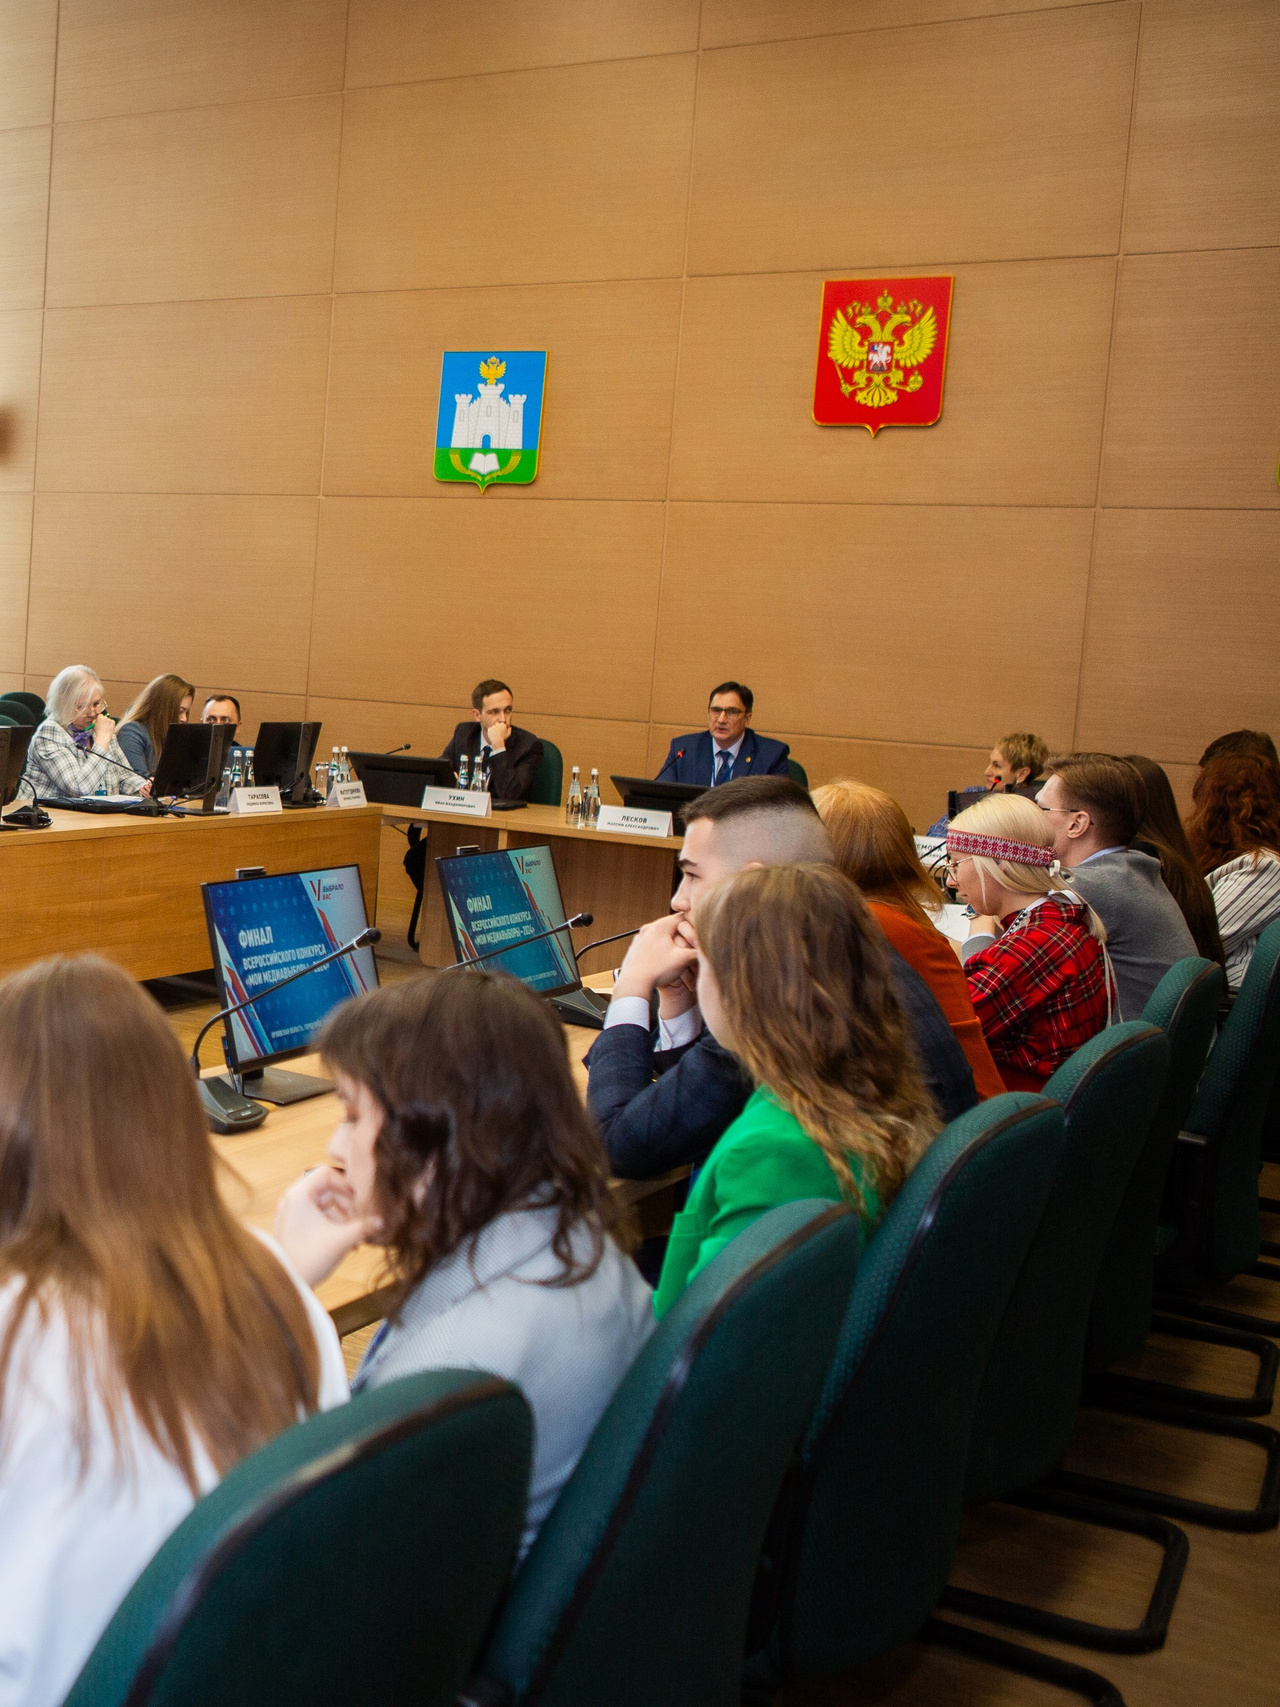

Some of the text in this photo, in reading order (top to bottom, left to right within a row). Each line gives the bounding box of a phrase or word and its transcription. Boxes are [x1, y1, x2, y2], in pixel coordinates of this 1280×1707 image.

[621, 815, 648, 824] ЛЕСКОВ
[322, 883, 345, 892] ВЫБРАЛО
[322, 893, 332, 901] ВАС
[466, 895, 492, 913] ФИНАЛ
[471, 911, 532, 932] ВСЕРОССИЙСКОГО КОНКУРСА
[238, 926, 274, 949] ФИНАЛ
[242, 943, 327, 971] ВСЕРОССИЙСКОГО КОНКУРСА
